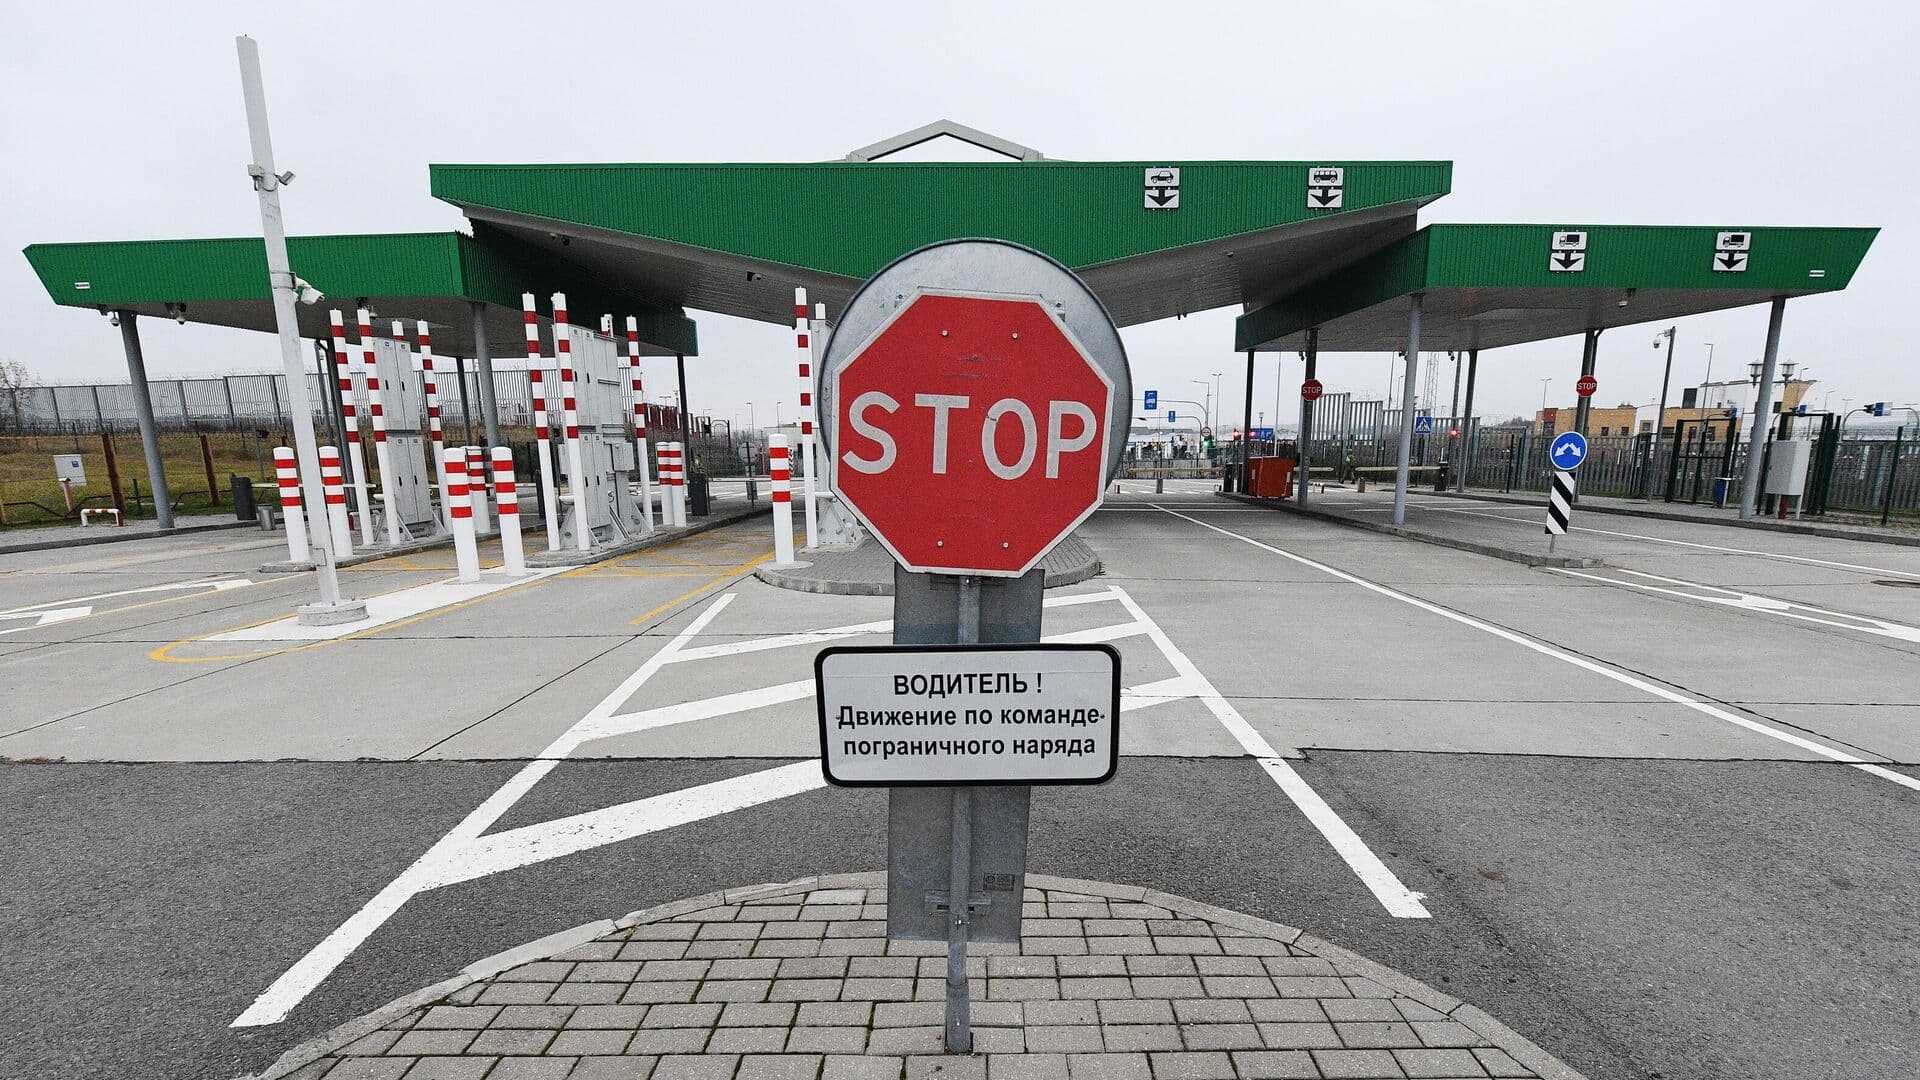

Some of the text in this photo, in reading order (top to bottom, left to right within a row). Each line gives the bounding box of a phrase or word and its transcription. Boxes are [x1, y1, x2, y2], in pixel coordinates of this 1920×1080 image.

[1302, 386, 1322, 394] STOP
[1577, 382, 1597, 390] STOP
[842, 391, 1097, 480] STOP
[894, 673, 1028, 698] ВОДИТЕЛЬ
[838, 705, 1099, 729] Движение по команде
[844, 737, 1096, 759] пограничного наряда
